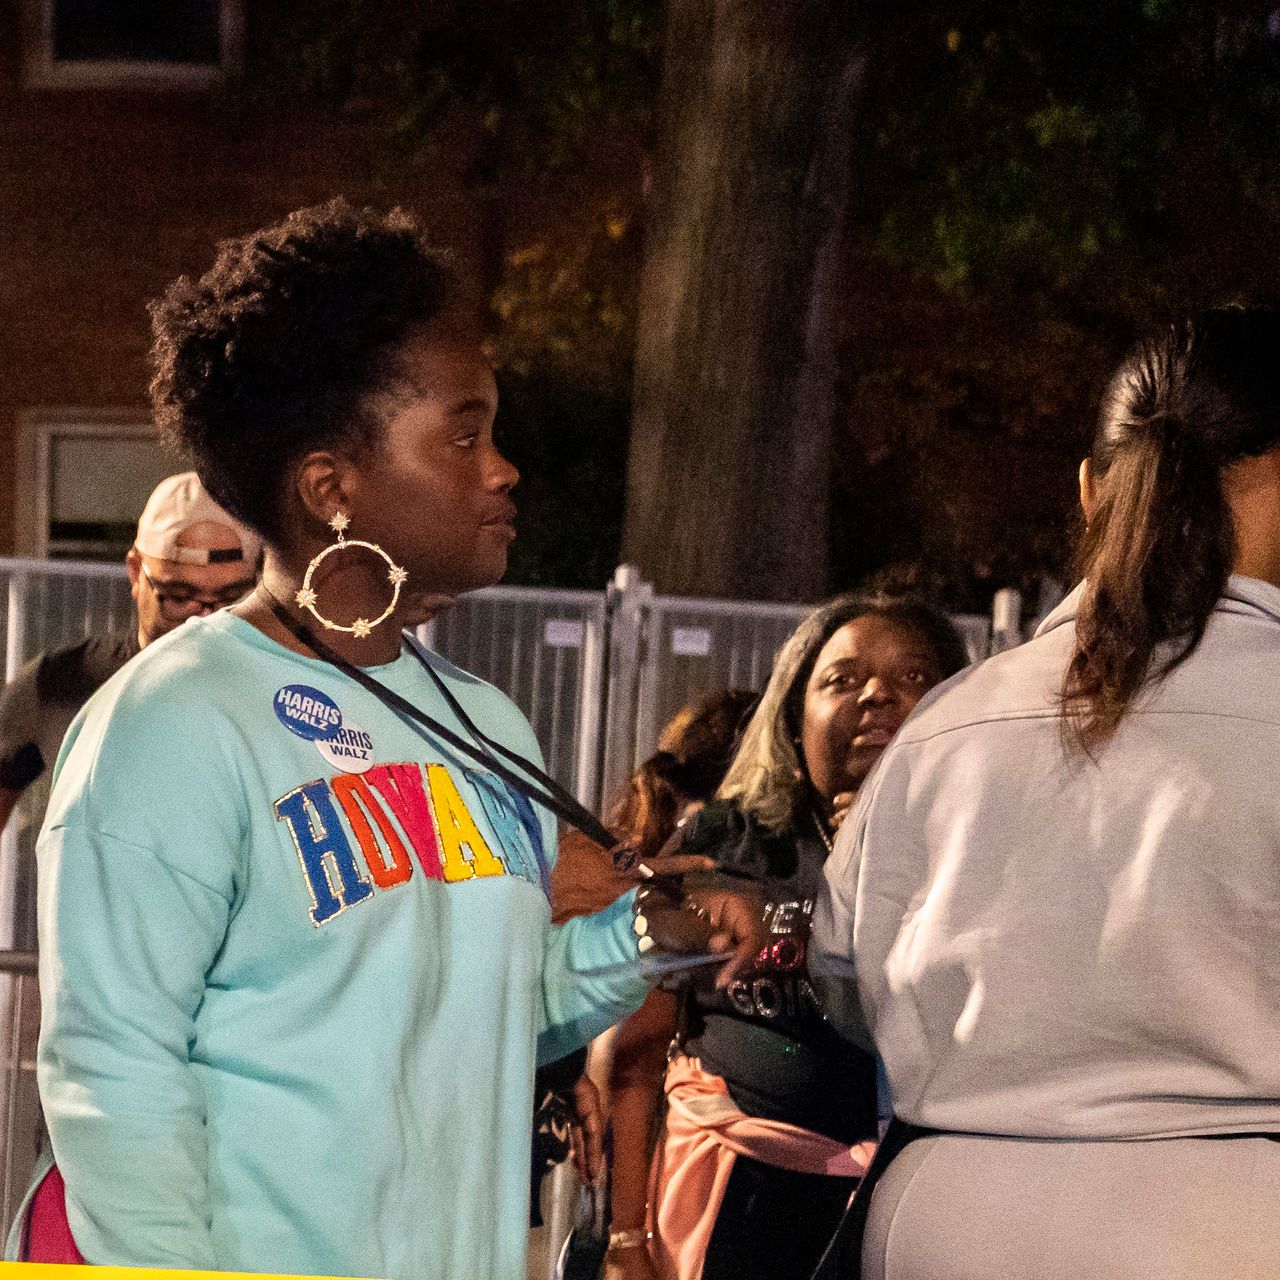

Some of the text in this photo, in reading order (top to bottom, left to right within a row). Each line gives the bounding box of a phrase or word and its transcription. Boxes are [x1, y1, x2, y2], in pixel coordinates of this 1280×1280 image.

[278, 689, 341, 725] HARRIS
[285, 706, 329, 731] WALZ
[320, 727, 374, 751] ARRIS
[330, 744, 369, 761] WALZ
